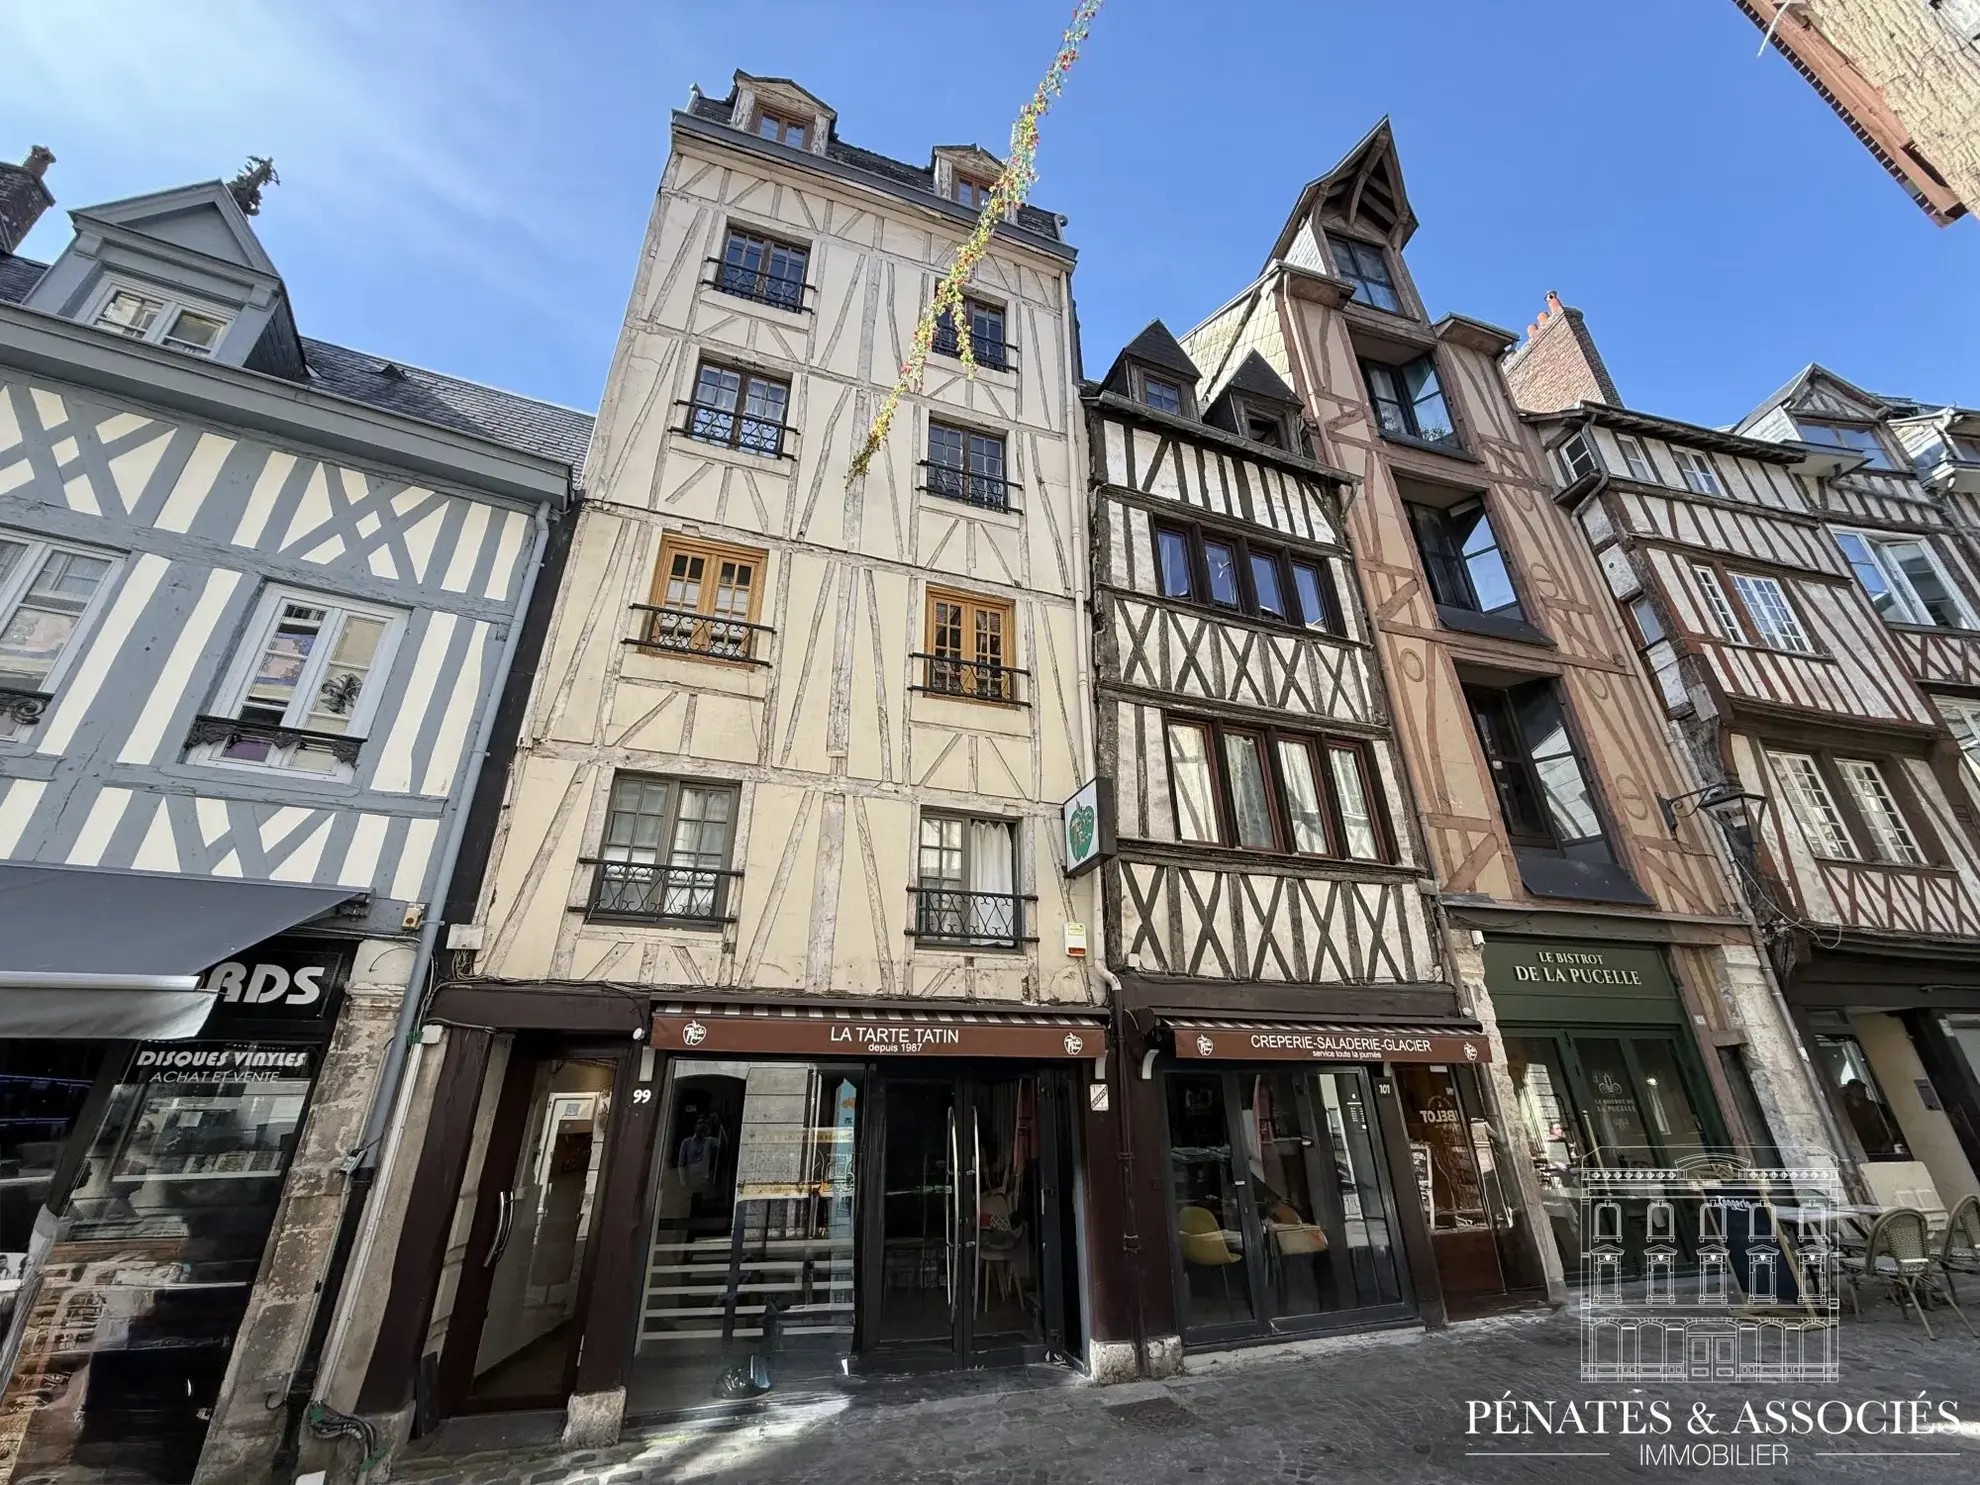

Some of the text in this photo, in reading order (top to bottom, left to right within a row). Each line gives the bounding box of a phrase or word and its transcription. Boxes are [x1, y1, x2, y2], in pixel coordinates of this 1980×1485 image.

[1539, 952, 1603, 965] LE BISTROT
[1514, 965, 1642, 985] DE LA PUCELLE
[200, 961, 325, 1005] RDS
[830, 1026, 959, 1044] LA TARTE TATIN
[868, 1043, 922, 1053] depuis 1987
[1250, 1035, 1432, 1052] CREPERIE-SALADERIE-GLACIER
[136, 1051, 306, 1067] DISQUES VINYLES
[149, 1071, 280, 1082] ACHAT ET VENTE
[633, 1089, 651, 1103] 99
[1379, 1084, 1390, 1095] 101
